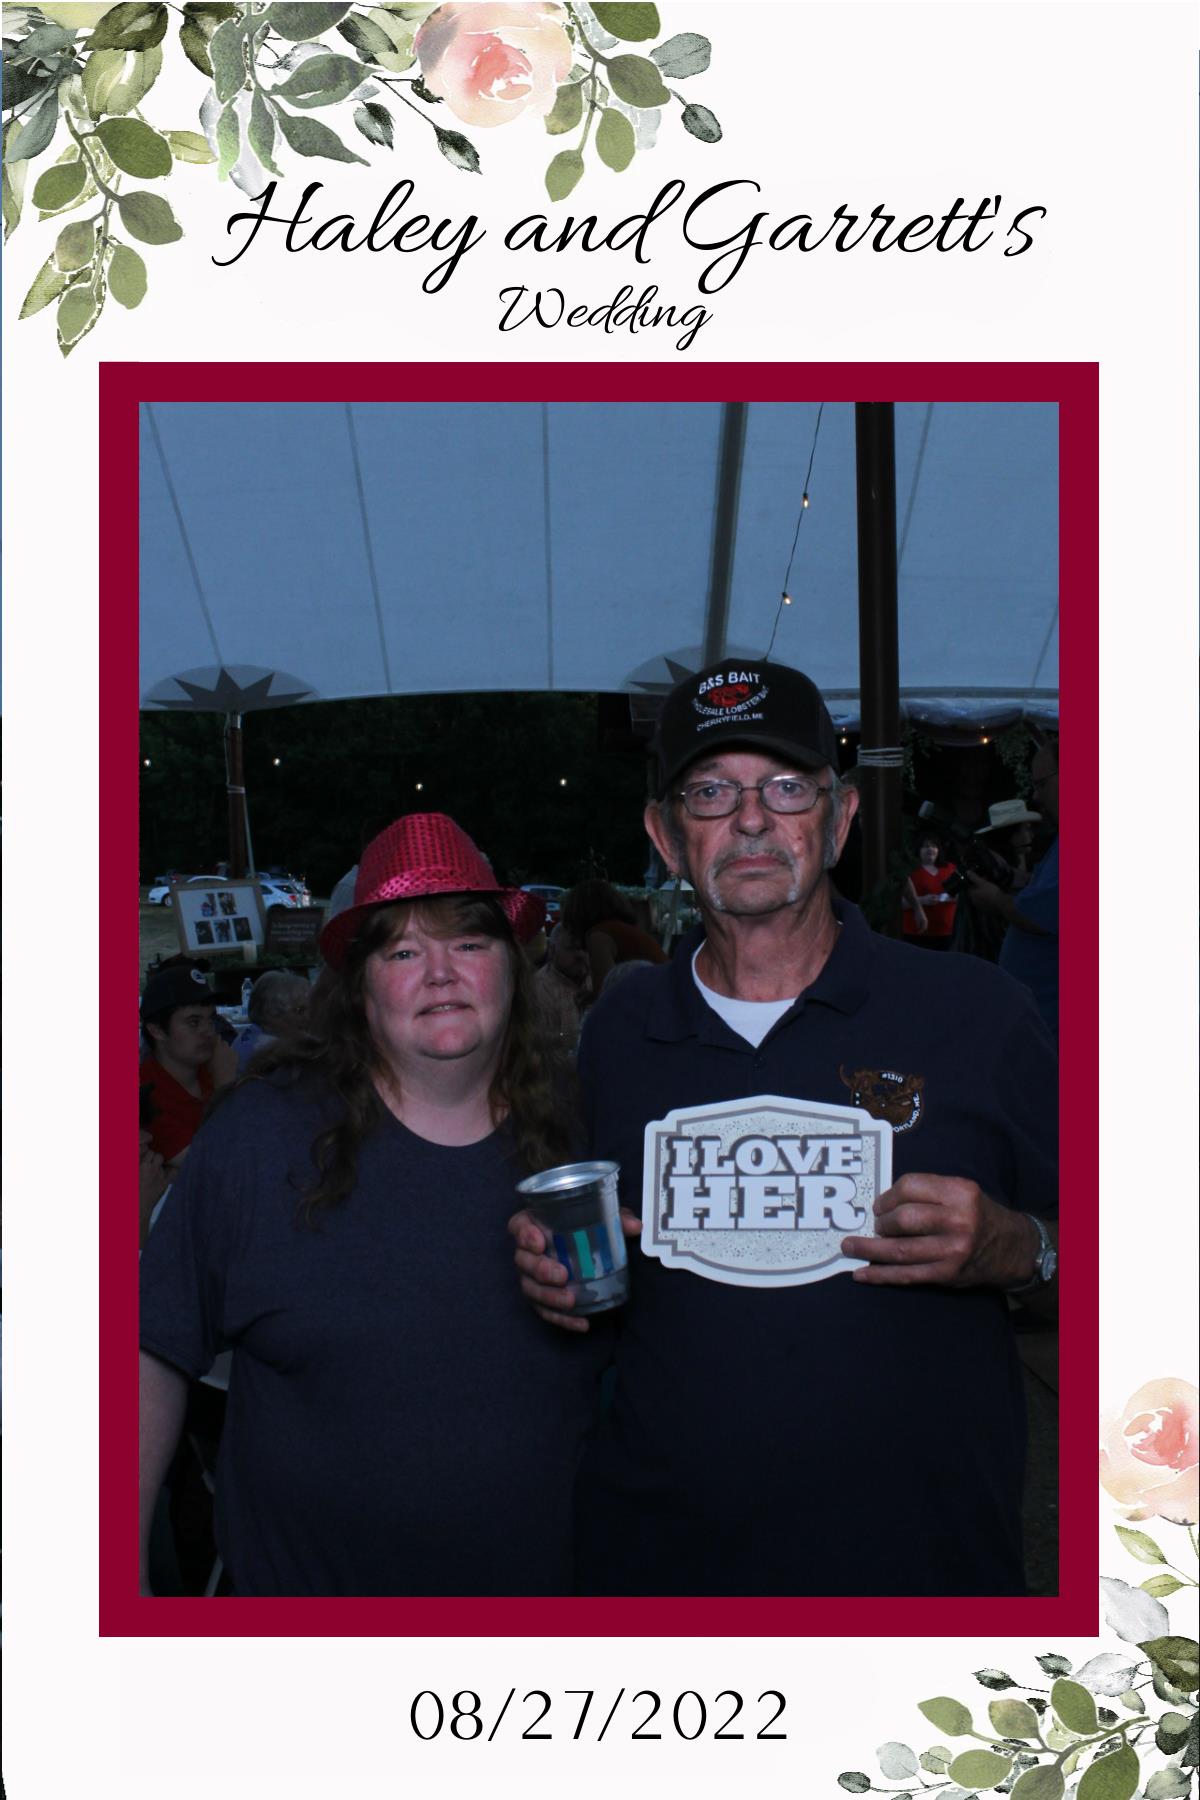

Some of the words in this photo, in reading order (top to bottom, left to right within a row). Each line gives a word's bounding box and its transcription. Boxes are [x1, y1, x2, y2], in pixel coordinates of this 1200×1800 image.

[698, 674, 724, 695] B&S
[728, 671, 760, 684] BAIT
[726, 694, 761, 714] LOBSTER
[881, 1073, 903, 1084] #1310
[892, 1109, 920, 1132] ORTLAND,
[666, 1136, 694, 1176] I
[695, 1134, 863, 1176] LOVE
[663, 1174, 867, 1232] HER
